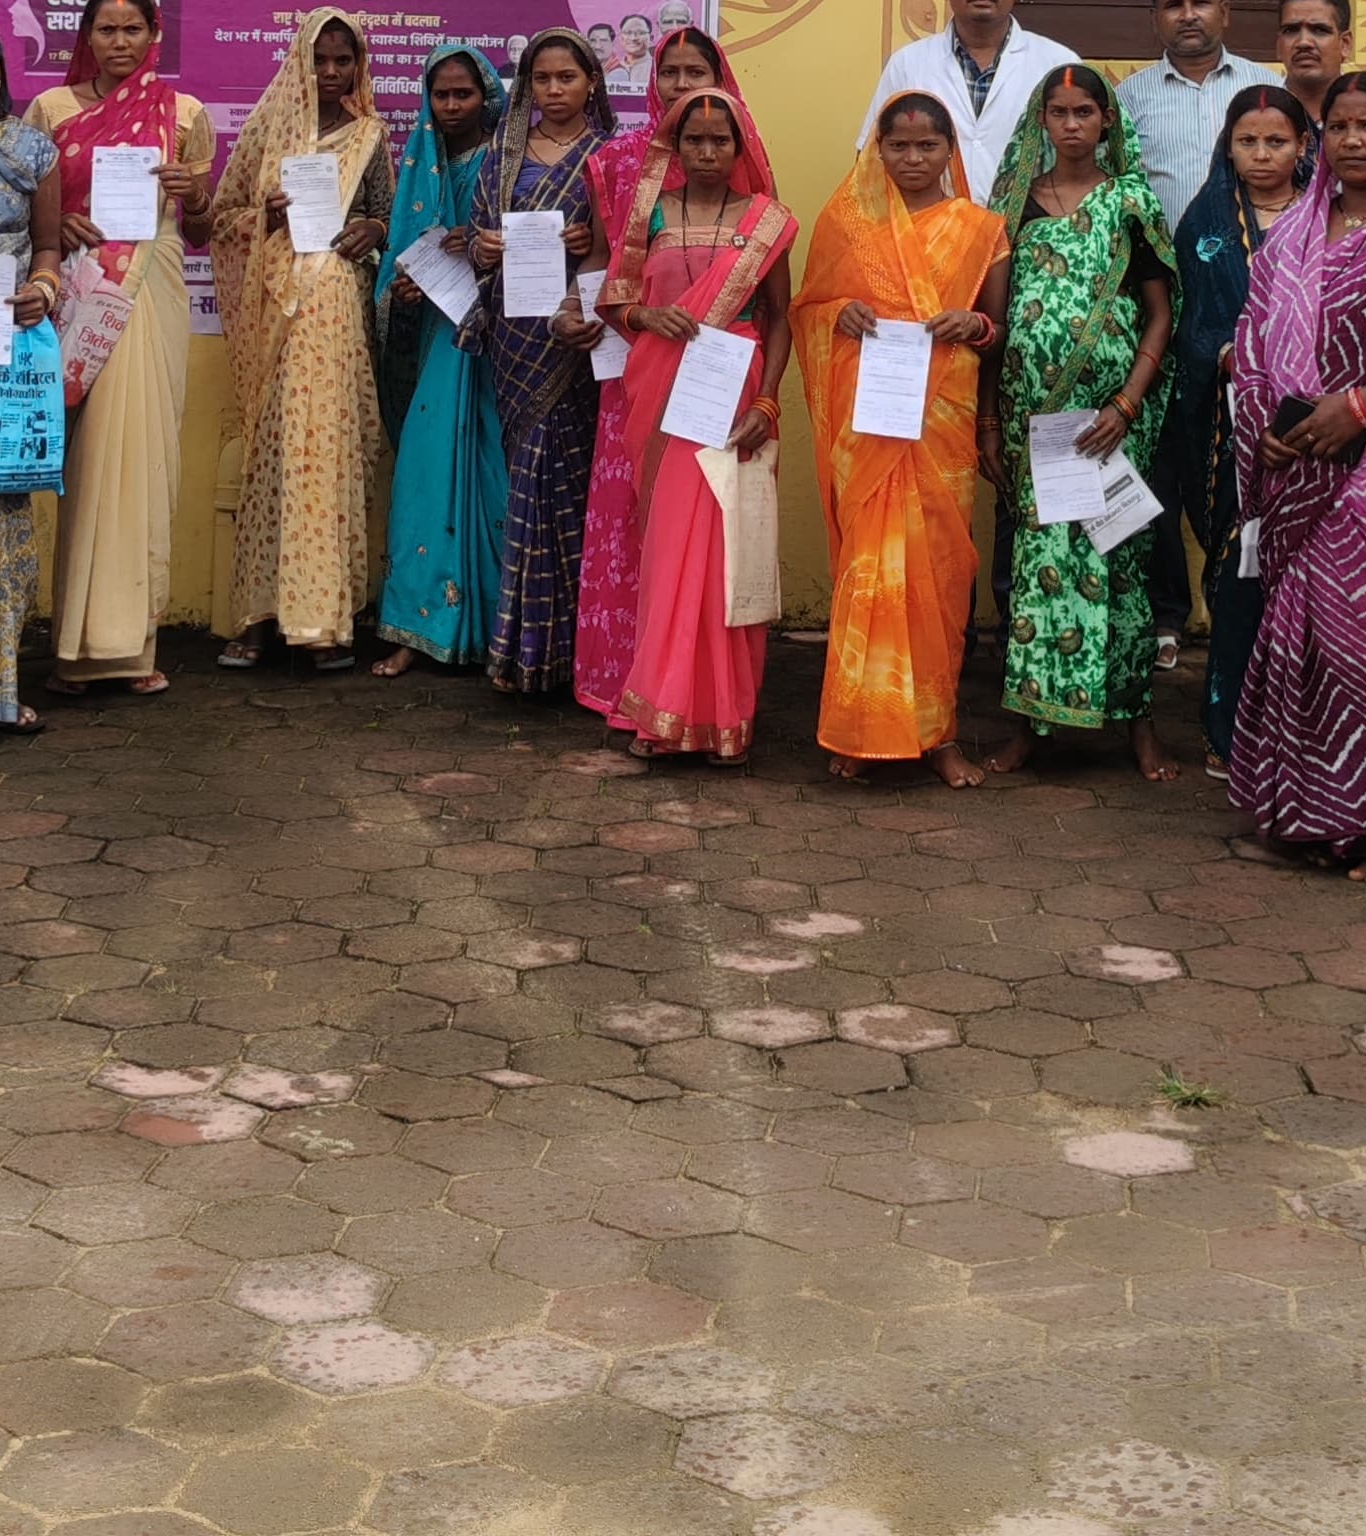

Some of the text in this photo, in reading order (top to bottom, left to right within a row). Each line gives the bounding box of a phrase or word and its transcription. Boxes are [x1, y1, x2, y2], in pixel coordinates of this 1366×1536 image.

[392, 12, 402, 26] में
[404, 15, 441, 27] बदलाव
[214, 28, 233, 42] देश
[252, 28, 261, 42] में
[371, 34, 407, 46] स्वास्थ्य
[464, 34, 506, 48] आयोजन
